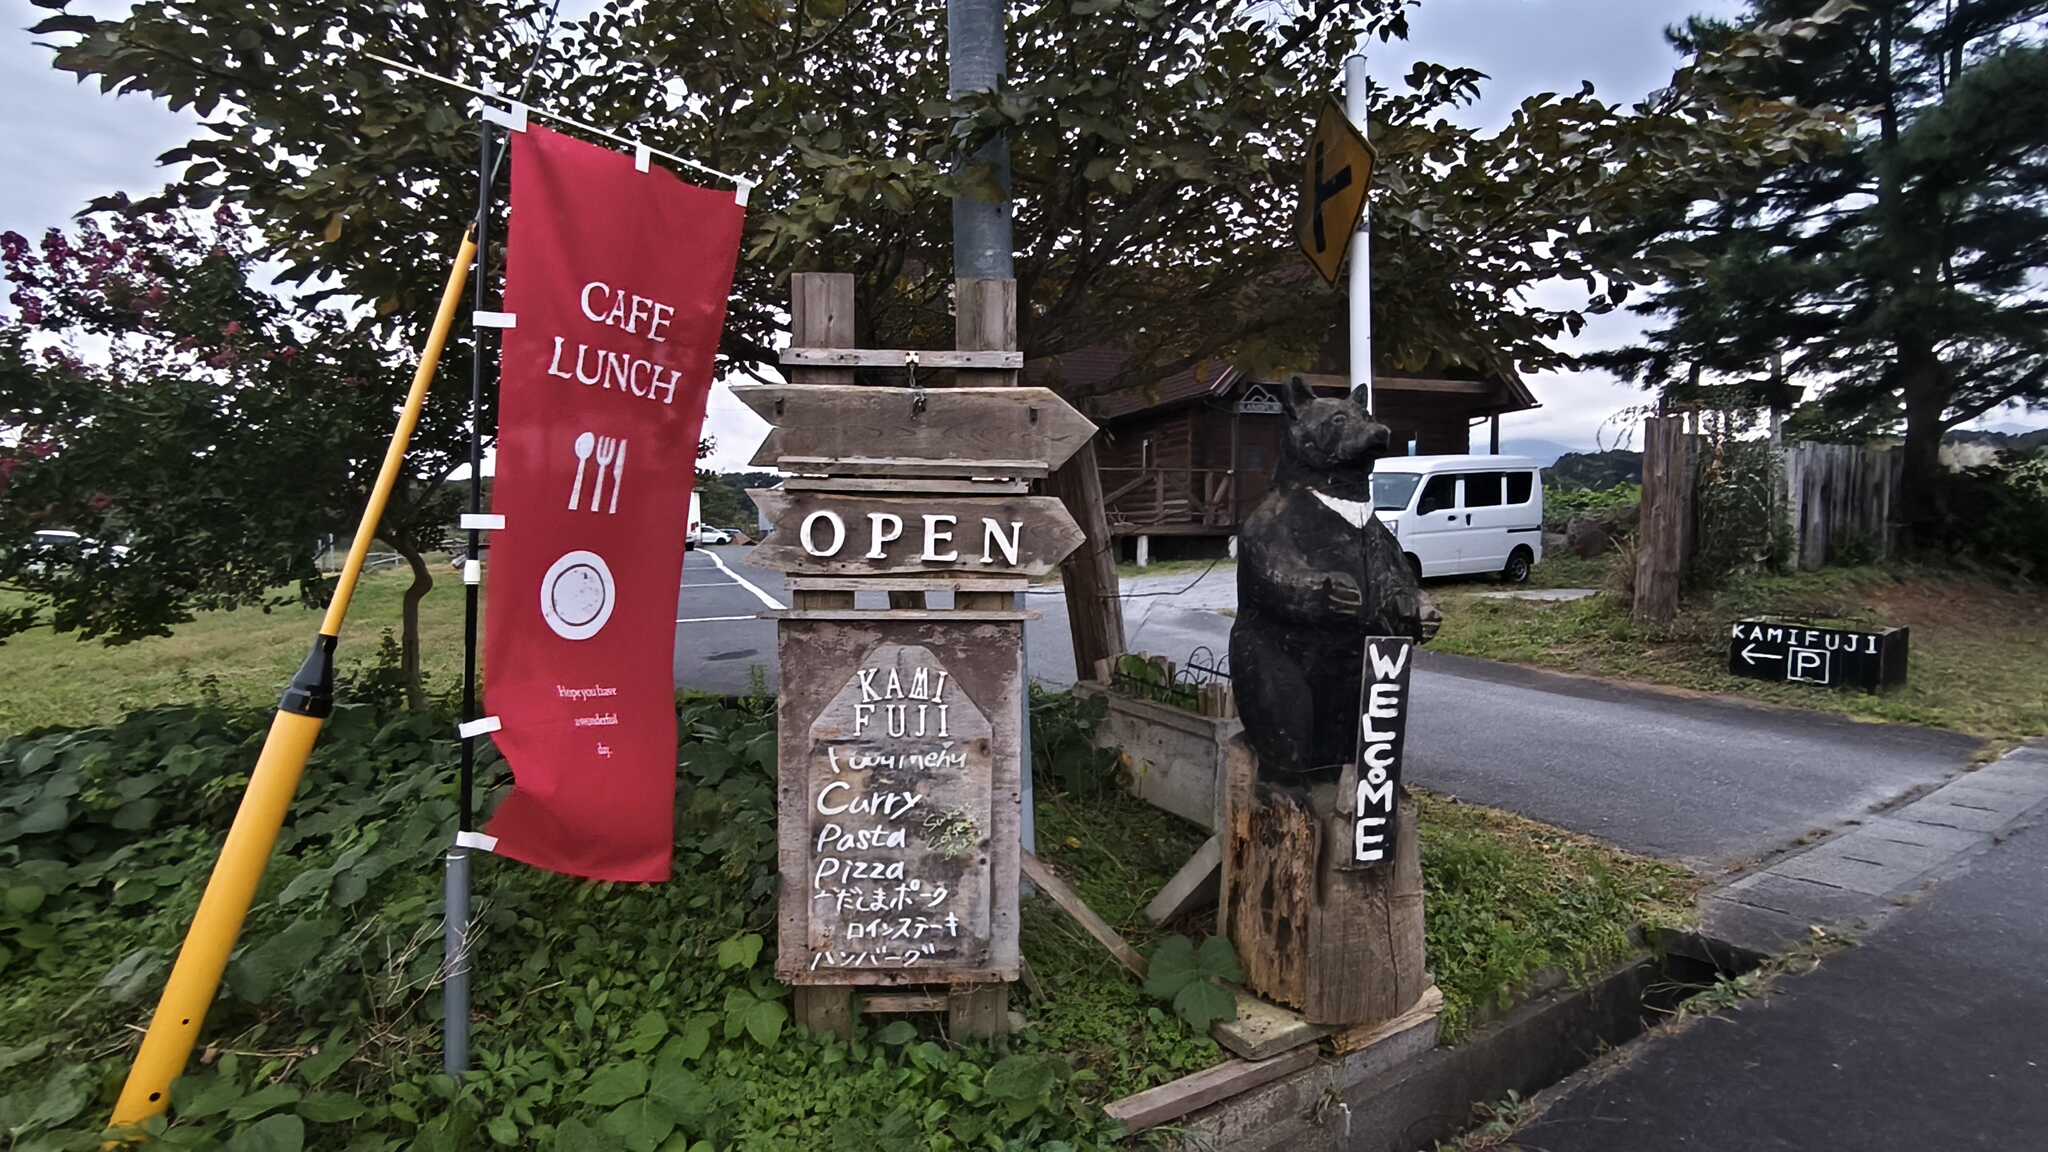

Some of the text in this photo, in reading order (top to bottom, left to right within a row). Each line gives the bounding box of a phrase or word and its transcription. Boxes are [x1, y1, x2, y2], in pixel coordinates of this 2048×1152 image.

[581, 281, 675, 343] CAFE
[548, 336, 682, 404] LUNCH
[800, 510, 1024, 566] OPEN
[1732, 623, 1879, 654] KAMIFUJI
[1797, 652, 1821, 677] P
[856, 667, 949, 704] KAMI
[853, 704, 950, 738] FUJI
[1355, 643, 1409, 861] WELCOME
[816, 781, 923, 819] Curry
[817, 824, 906, 852] Pasta
[815, 857, 905, 889] Pizza
[847, 912, 960, 940] ロインステーキ
[810, 943, 936, 971] ハンバーグ
